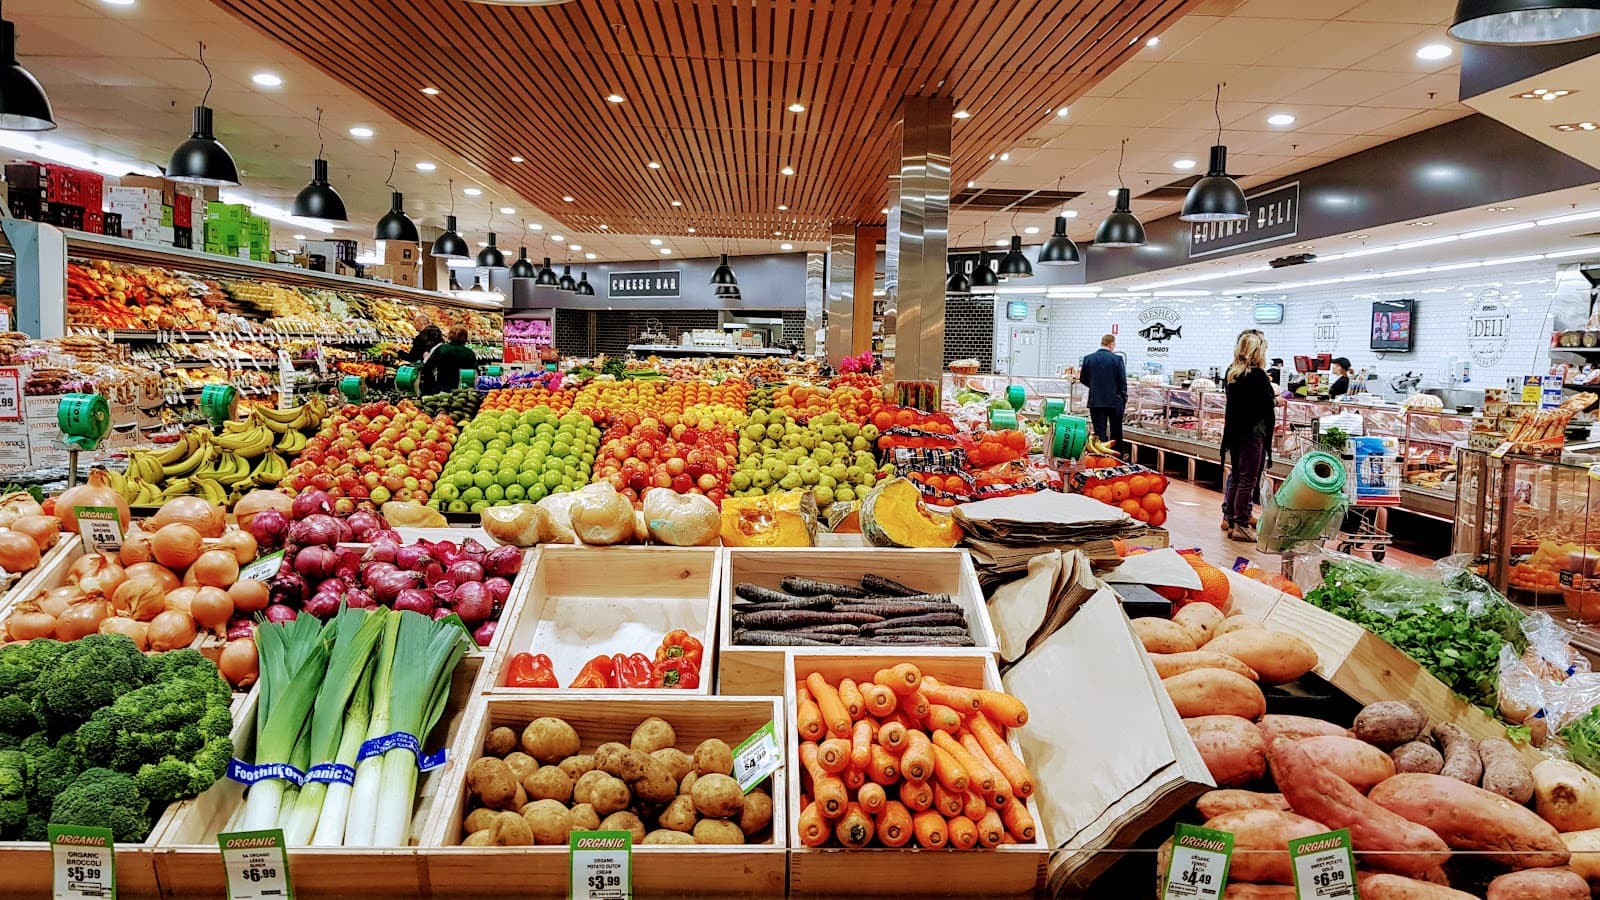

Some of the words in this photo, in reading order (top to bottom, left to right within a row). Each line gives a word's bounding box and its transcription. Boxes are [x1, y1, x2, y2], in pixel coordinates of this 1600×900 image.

[1257, 199, 1291, 229] DELI
[612, 279, 651, 290] CHEESE
[656, 278, 676, 290] BAR
[1139, 309, 1180, 324] FRESHEST
[1317, 325, 1336, 340] DELI
[1474, 319, 1504, 337] DELI
[79, 510, 113, 520] ORGANIC
[92, 533, 116, 544] $4.99
[56, 834, 106, 846] ORGANIC
[226, 837, 276, 849] ORGANIC
[577, 838, 626, 849] ORGANIC
[1180, 835, 1226, 852] ORGANIC
[1297, 837, 1342, 855] ORGANIC
[66, 858, 102, 867] BROCCOLI
[67, 851, 99, 859] ORGANIC
[67, 866, 101, 882] $5.99
[242, 868, 277, 883] $6.99
[1182, 870, 1212, 886] $4.49
[1313, 870, 1345, 887] $6.99
[588, 875, 620, 890] $3.99
